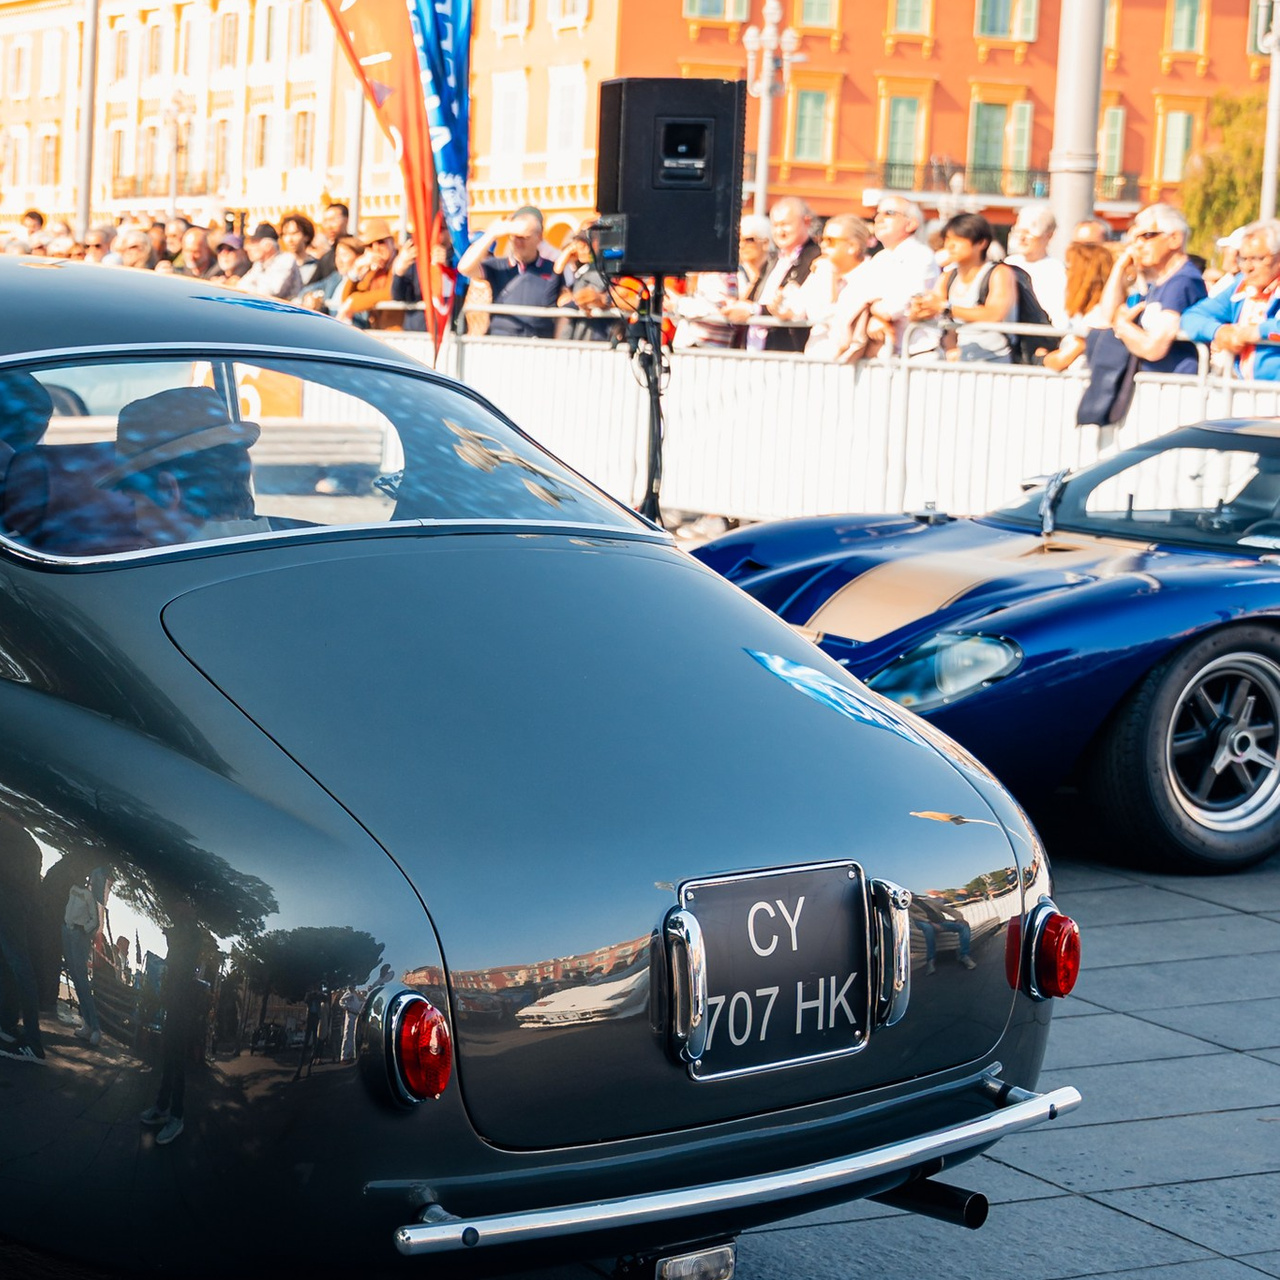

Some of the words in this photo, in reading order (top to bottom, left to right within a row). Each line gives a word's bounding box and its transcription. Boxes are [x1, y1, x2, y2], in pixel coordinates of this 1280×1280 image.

[747, 896, 805, 957] CY
[705, 986, 780, 1051] 707
[795, 972, 858, 1034] HK
